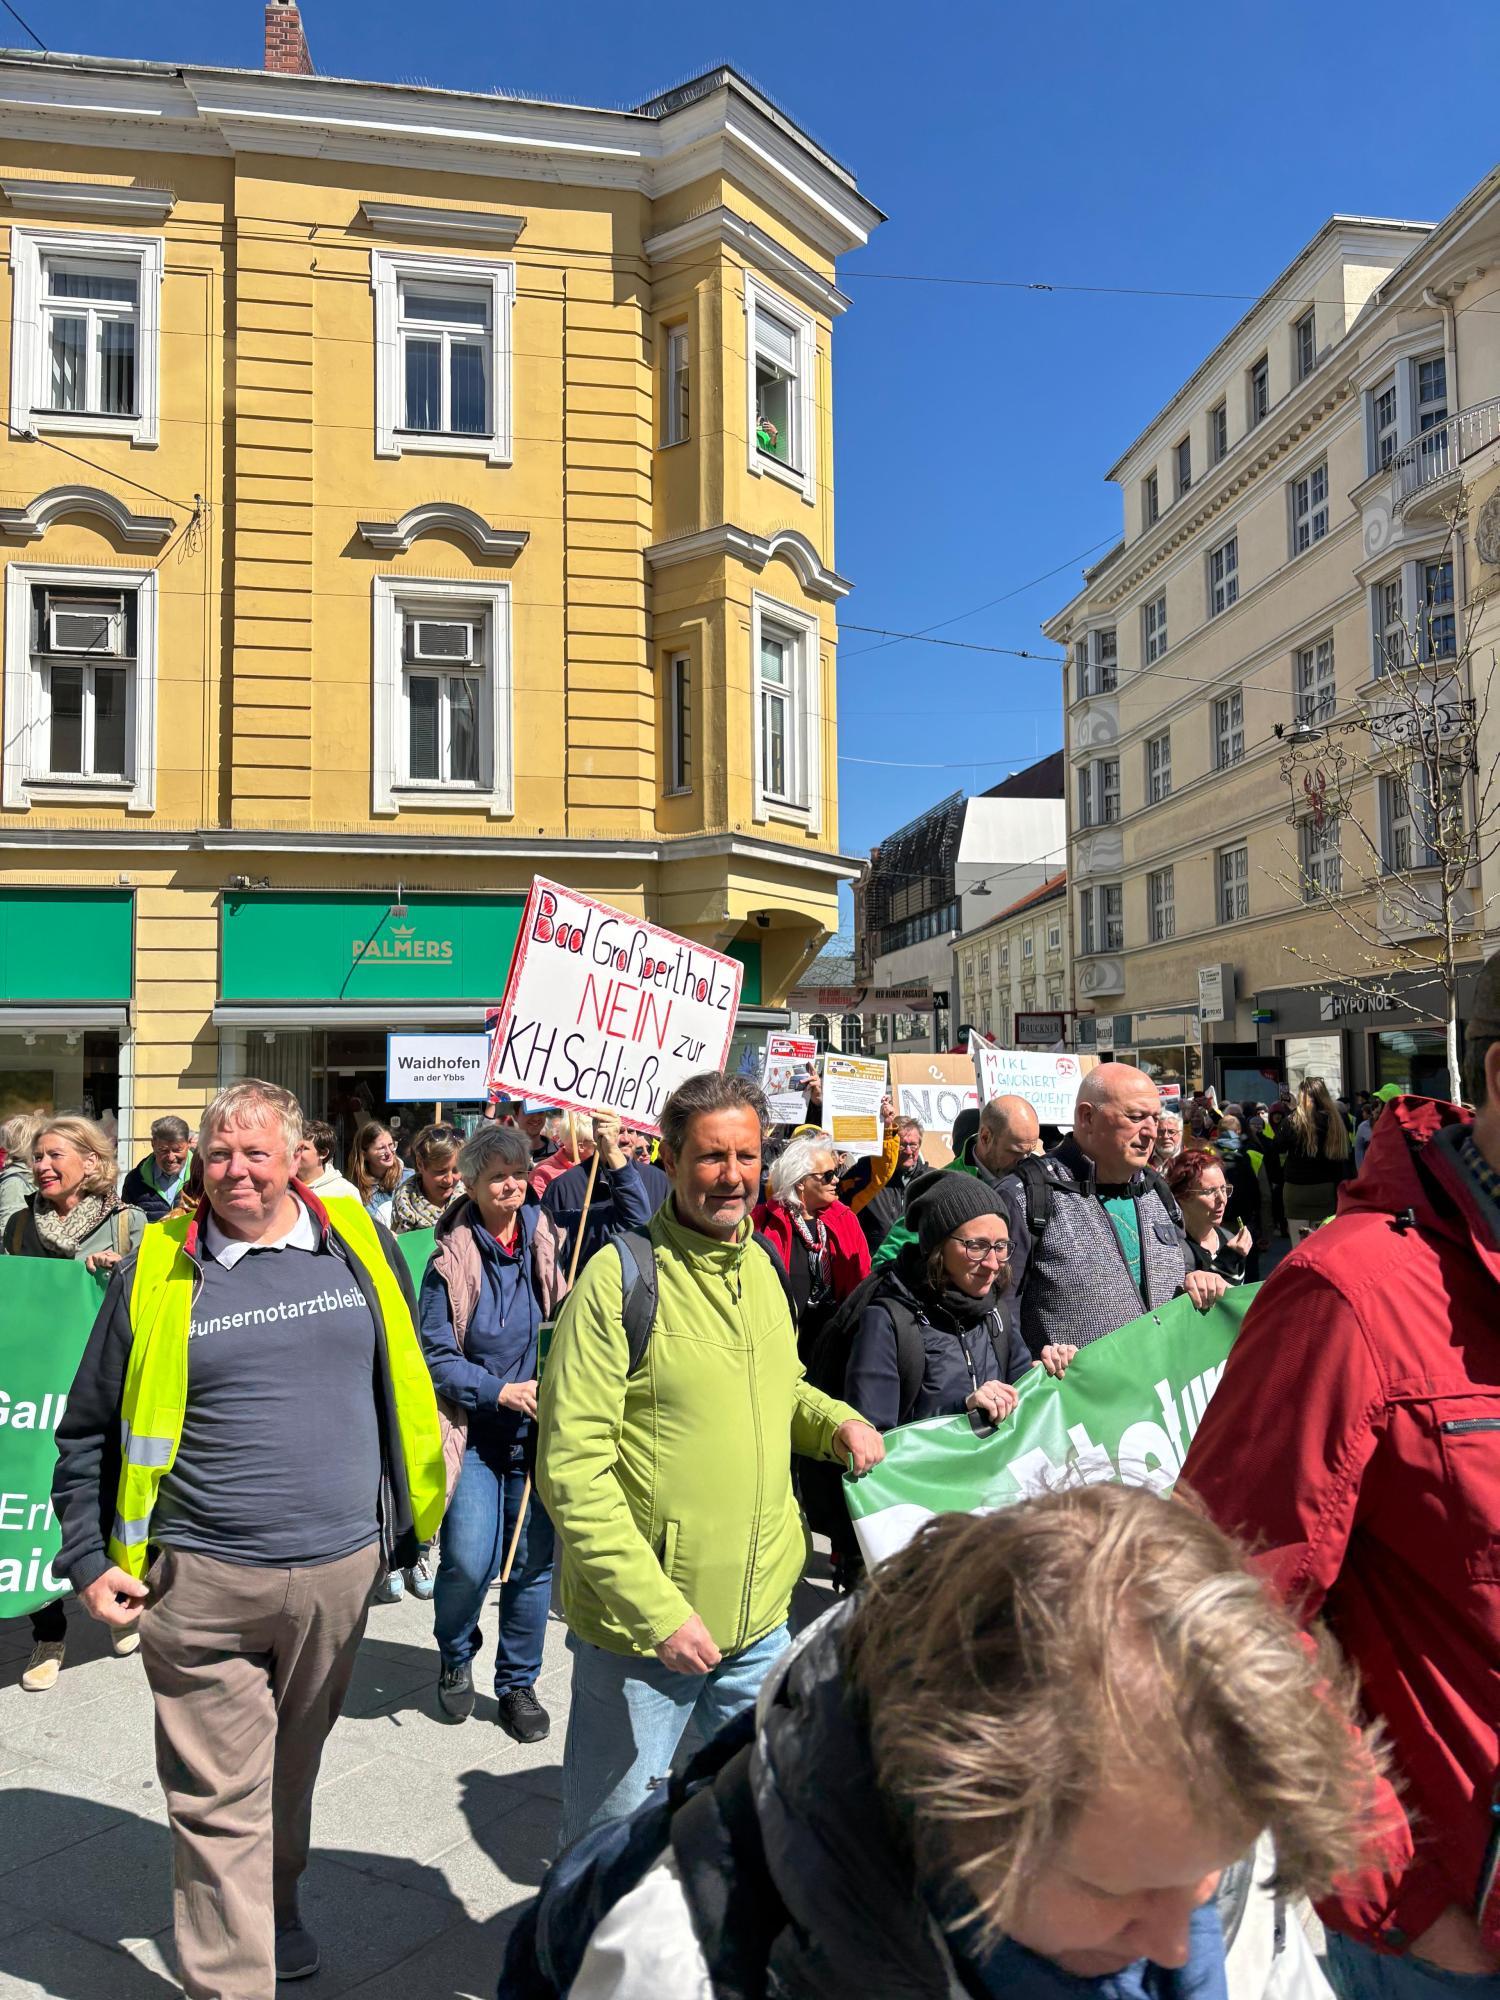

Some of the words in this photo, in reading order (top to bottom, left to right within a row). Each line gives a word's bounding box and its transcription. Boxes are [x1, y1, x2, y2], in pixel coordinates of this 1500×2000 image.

[352, 940, 453, 958] PALMERS
[532, 889, 592, 956] Bad
[592, 919, 732, 1011] Großpertholz
[1334, 996, 1365, 1016] HYPO
[1367, 995, 1392, 1012] NOE
[576, 973, 673, 1050] NEIN
[672, 1034, 706, 1063] zur
[1020, 1022, 1059, 1034] BRUCKNER
[398, 1056, 481, 1069] Waidhofen
[413, 1074, 424, 1082] an
[426, 1073, 441, 1082] der
[443, 1073, 465, 1082] Ybbs
[553, 1033, 673, 1118] Schließu
[1037, 1104, 1068, 1118] EUTE
